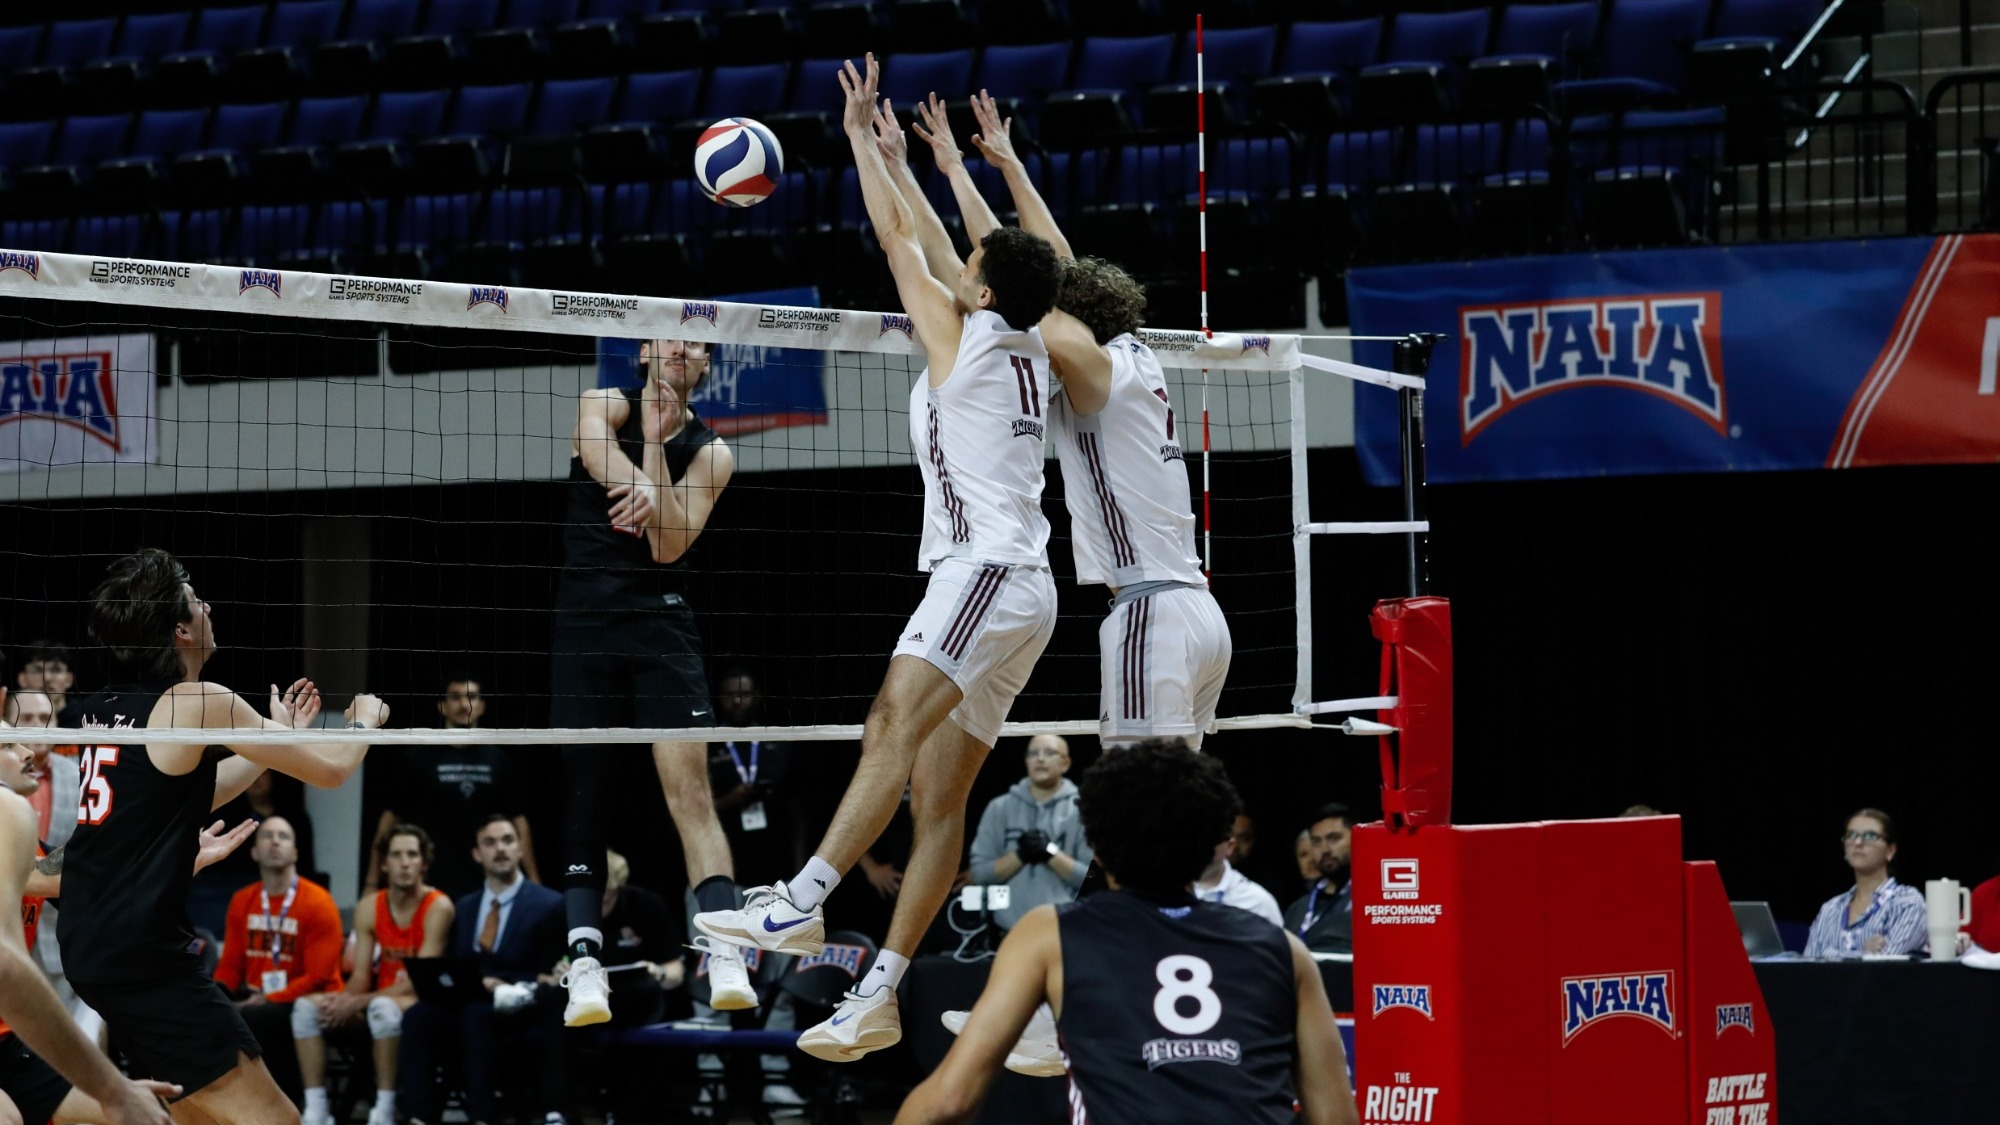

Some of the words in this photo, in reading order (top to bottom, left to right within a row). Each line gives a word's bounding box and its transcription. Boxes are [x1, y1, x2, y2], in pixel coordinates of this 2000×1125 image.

[111, 262, 190, 278] PERFORMANCE
[110, 275, 140, 285] SPORTS
[140, 277, 175, 288] SYSTEMS
[241, 270, 280, 295] NAIA
[347, 280, 422, 295] PERFORMANCE
[345, 291, 374, 302] SPORTS
[375, 293, 410, 304] SYSTEMS
[468, 287, 508, 309] NAIA
[570, 295, 638, 310] PERFORMANCE
[568, 308, 595, 317] SPORTS
[597, 310, 626, 320] SYSTEMS
[682, 302, 717, 323] NAIA
[777, 309, 841, 323] PERFORMANCE
[775, 320, 799, 331] SPORTS
[800, 322, 829, 332] SYSTEMS
[880, 314, 914, 337] NAIA
[1148, 342, 1169, 351] SPORTS
[1169, 344, 1196, 352] SYSTEMS
[1149, 332, 1207, 344] PERFORMANCE
[1242, 336, 1270, 351] NAIA
[1462, 297, 1723, 434] NAIA
[1009, 354, 1041, 418] 11
[0, 361, 113, 435] AIA
[1012, 418, 1044, 441] TIGERS
[77, 745, 119, 825] 25
[1383, 891, 1419, 900] GARED
[1364, 904, 1442, 916] PERFORMANCE
[1371, 915, 1401, 925] SPORTS
[1401, 915, 1436, 925] SYSTEMS
[1153, 954, 1222, 1035] 8
[1374, 985, 1431, 1016] NAIA
[1564, 974, 1673, 1039] NAIA
[1717, 1004, 1753, 1034] NAIA
[1143, 1038, 1241, 1069] TIGERS
[1394, 1072, 1411, 1084] THE
[1705, 1073, 1767, 1104] BATTLE
[1364, 1086, 1439, 1122] RIGHT
[1705, 1106, 1735, 1125] FOR
[1738, 1102, 1770, 1125] THE
